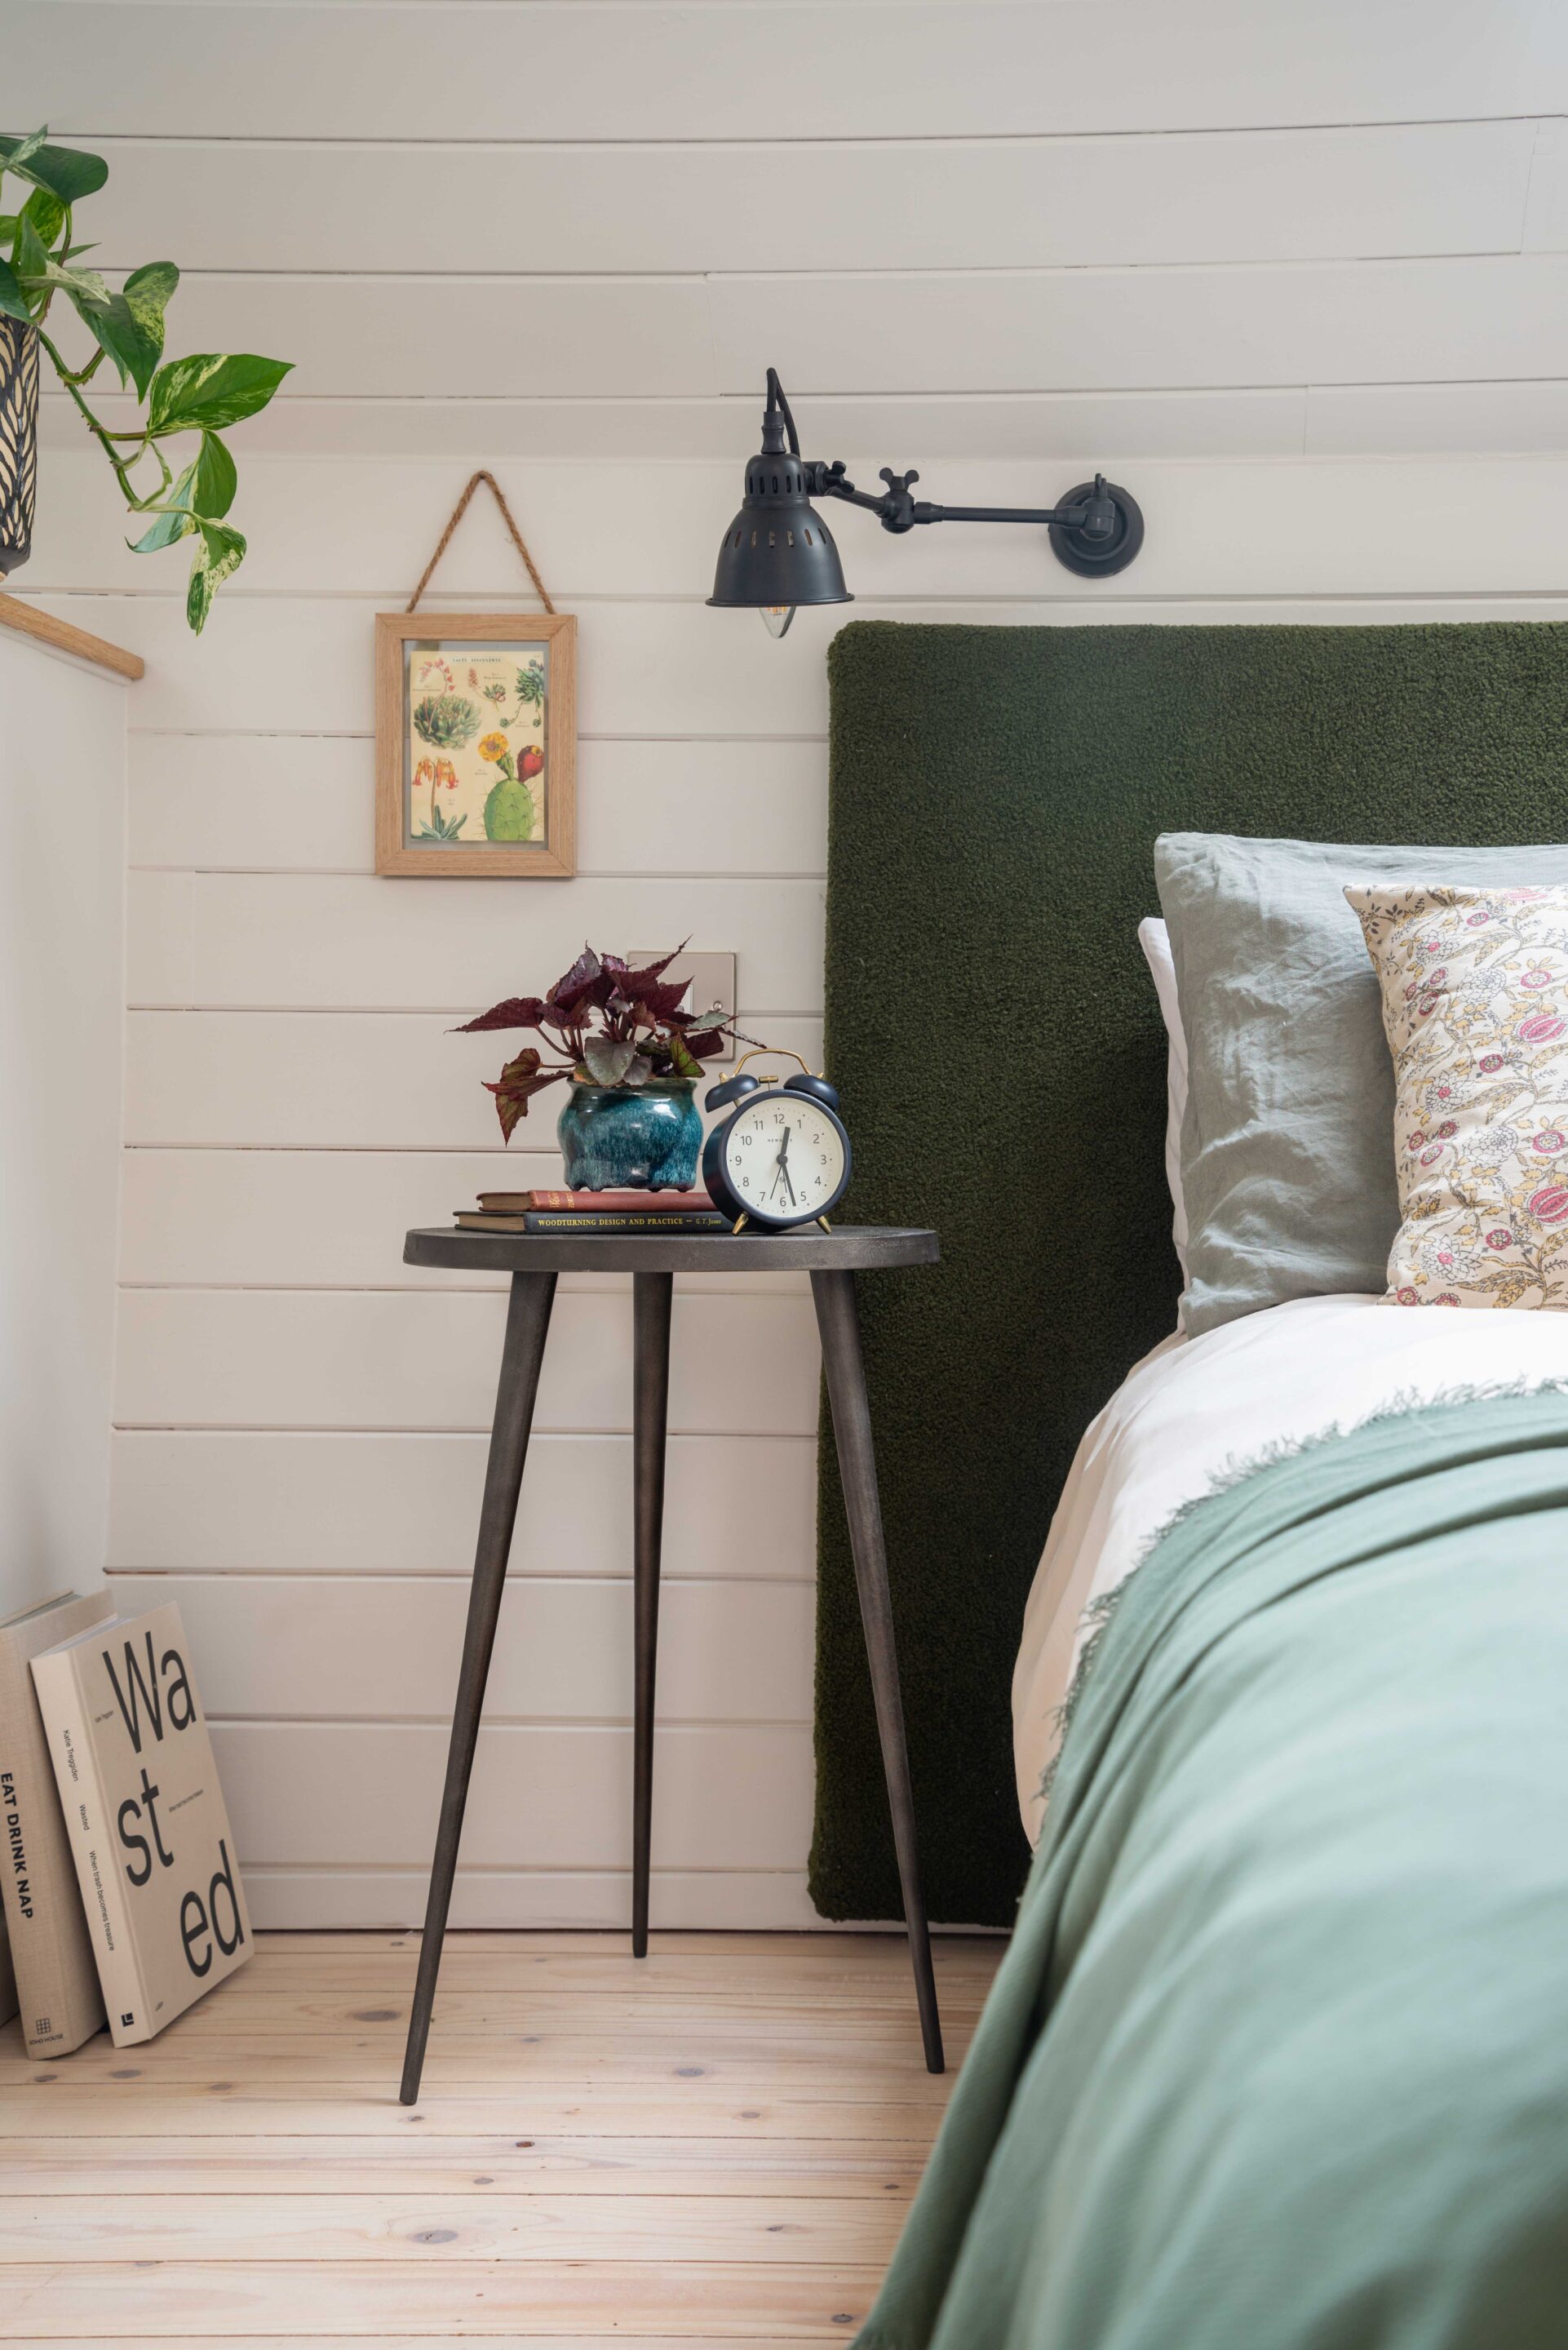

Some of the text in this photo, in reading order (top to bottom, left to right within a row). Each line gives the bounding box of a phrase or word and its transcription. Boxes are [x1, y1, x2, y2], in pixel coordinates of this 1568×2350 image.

[773, 1114, 785, 1124] 12
[797, 1120, 802, 1129] 1
[754, 1120, 764, 1130] 11
[740, 1135, 752, 1146] 10
[813, 1133, 820, 1144] 2
[735, 1155, 742, 1166] 9
[820, 1155, 826, 1165] 3
[742, 1177, 750, 1187] 8
[814, 1176, 822, 1186] 4
[760, 1191, 766, 1201] 7
[780, 1196, 786, 1207] 6
[800, 1191, 807, 1201] 5
[102, 1630, 197, 1754] Wa
[63, 1729, 71, 1747] Katie
[79, 1803, 91, 1831] Wasted
[117, 1767, 175, 1887] st
[1, 1772, 33, 1918] EAT DRINK NAP
[89, 1850, 115, 1952] When trash becomes treasure
[179, 1839, 245, 1977] ed
[44, 2033, 64, 2042] HOUSE
